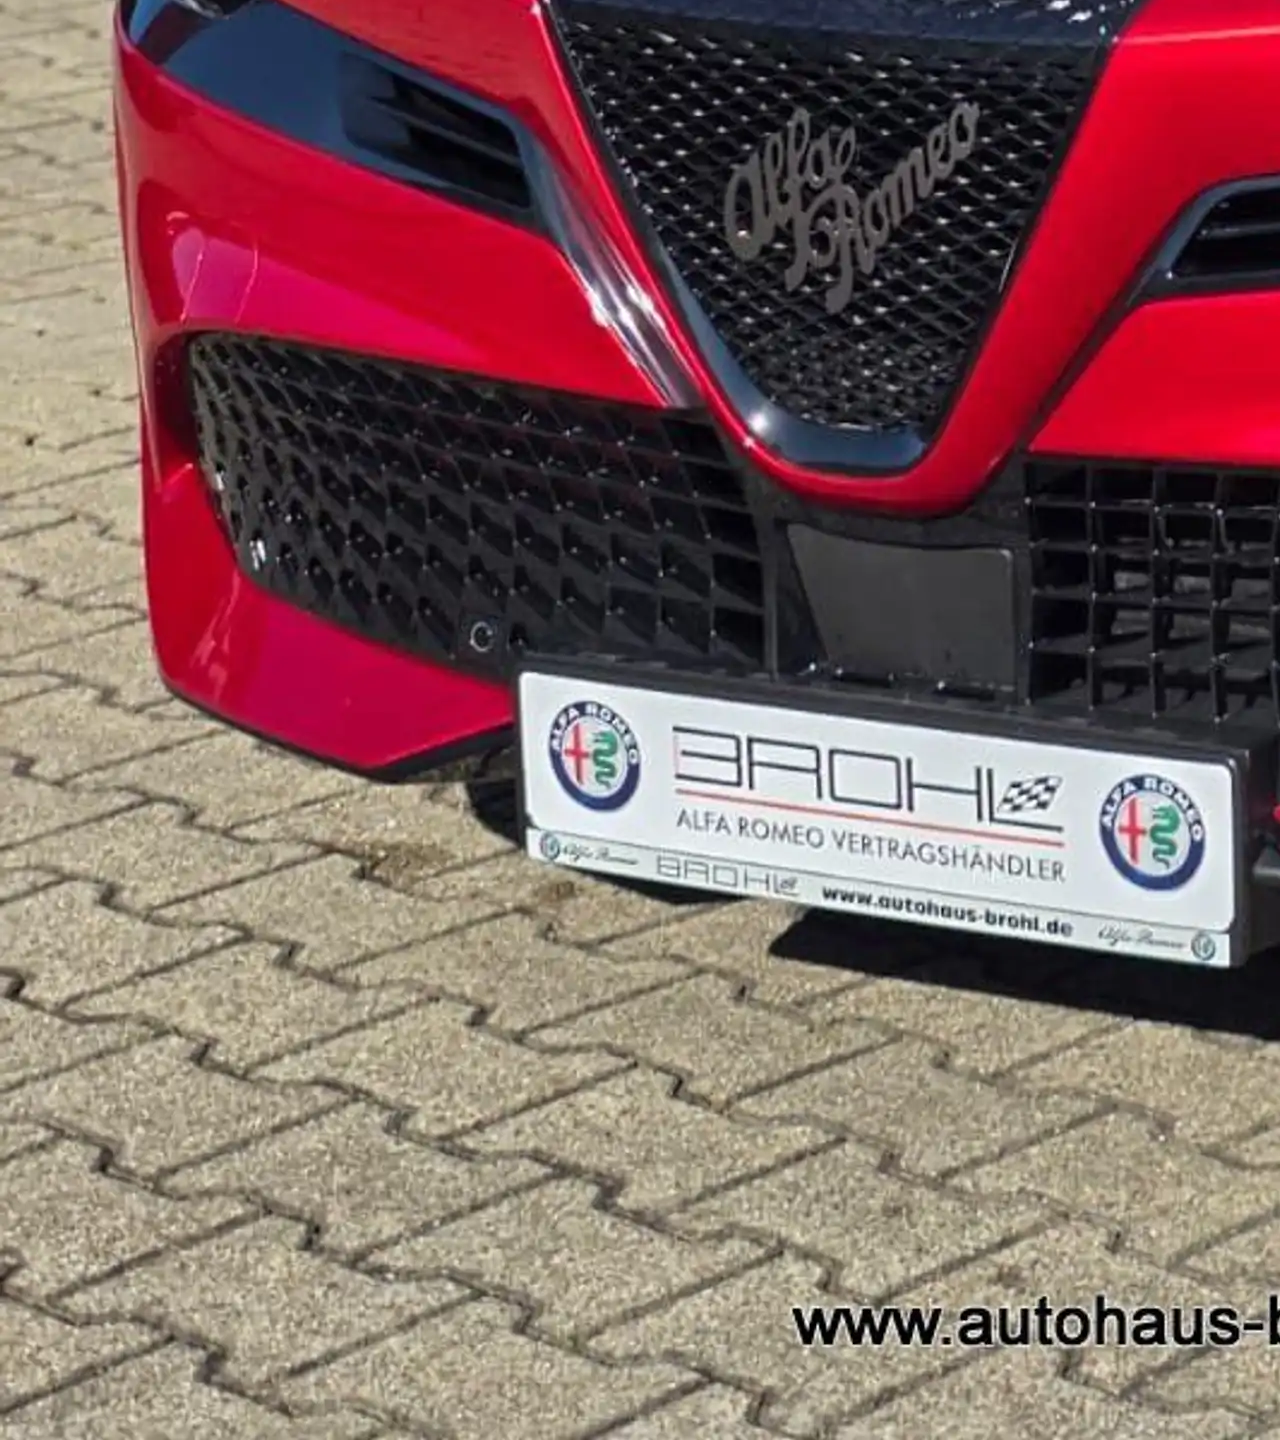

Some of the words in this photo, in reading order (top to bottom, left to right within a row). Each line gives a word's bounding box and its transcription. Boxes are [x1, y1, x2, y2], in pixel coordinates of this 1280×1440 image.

[672, 726, 1064, 832] BROHL
[676, 808, 734, 836] ALFA
[738, 817, 826, 850] ROMEO
[831, 827, 1066, 883] VERTRAGSHÄNDLER
[821, 885, 1074, 938] www.autohaus-brohl.de
